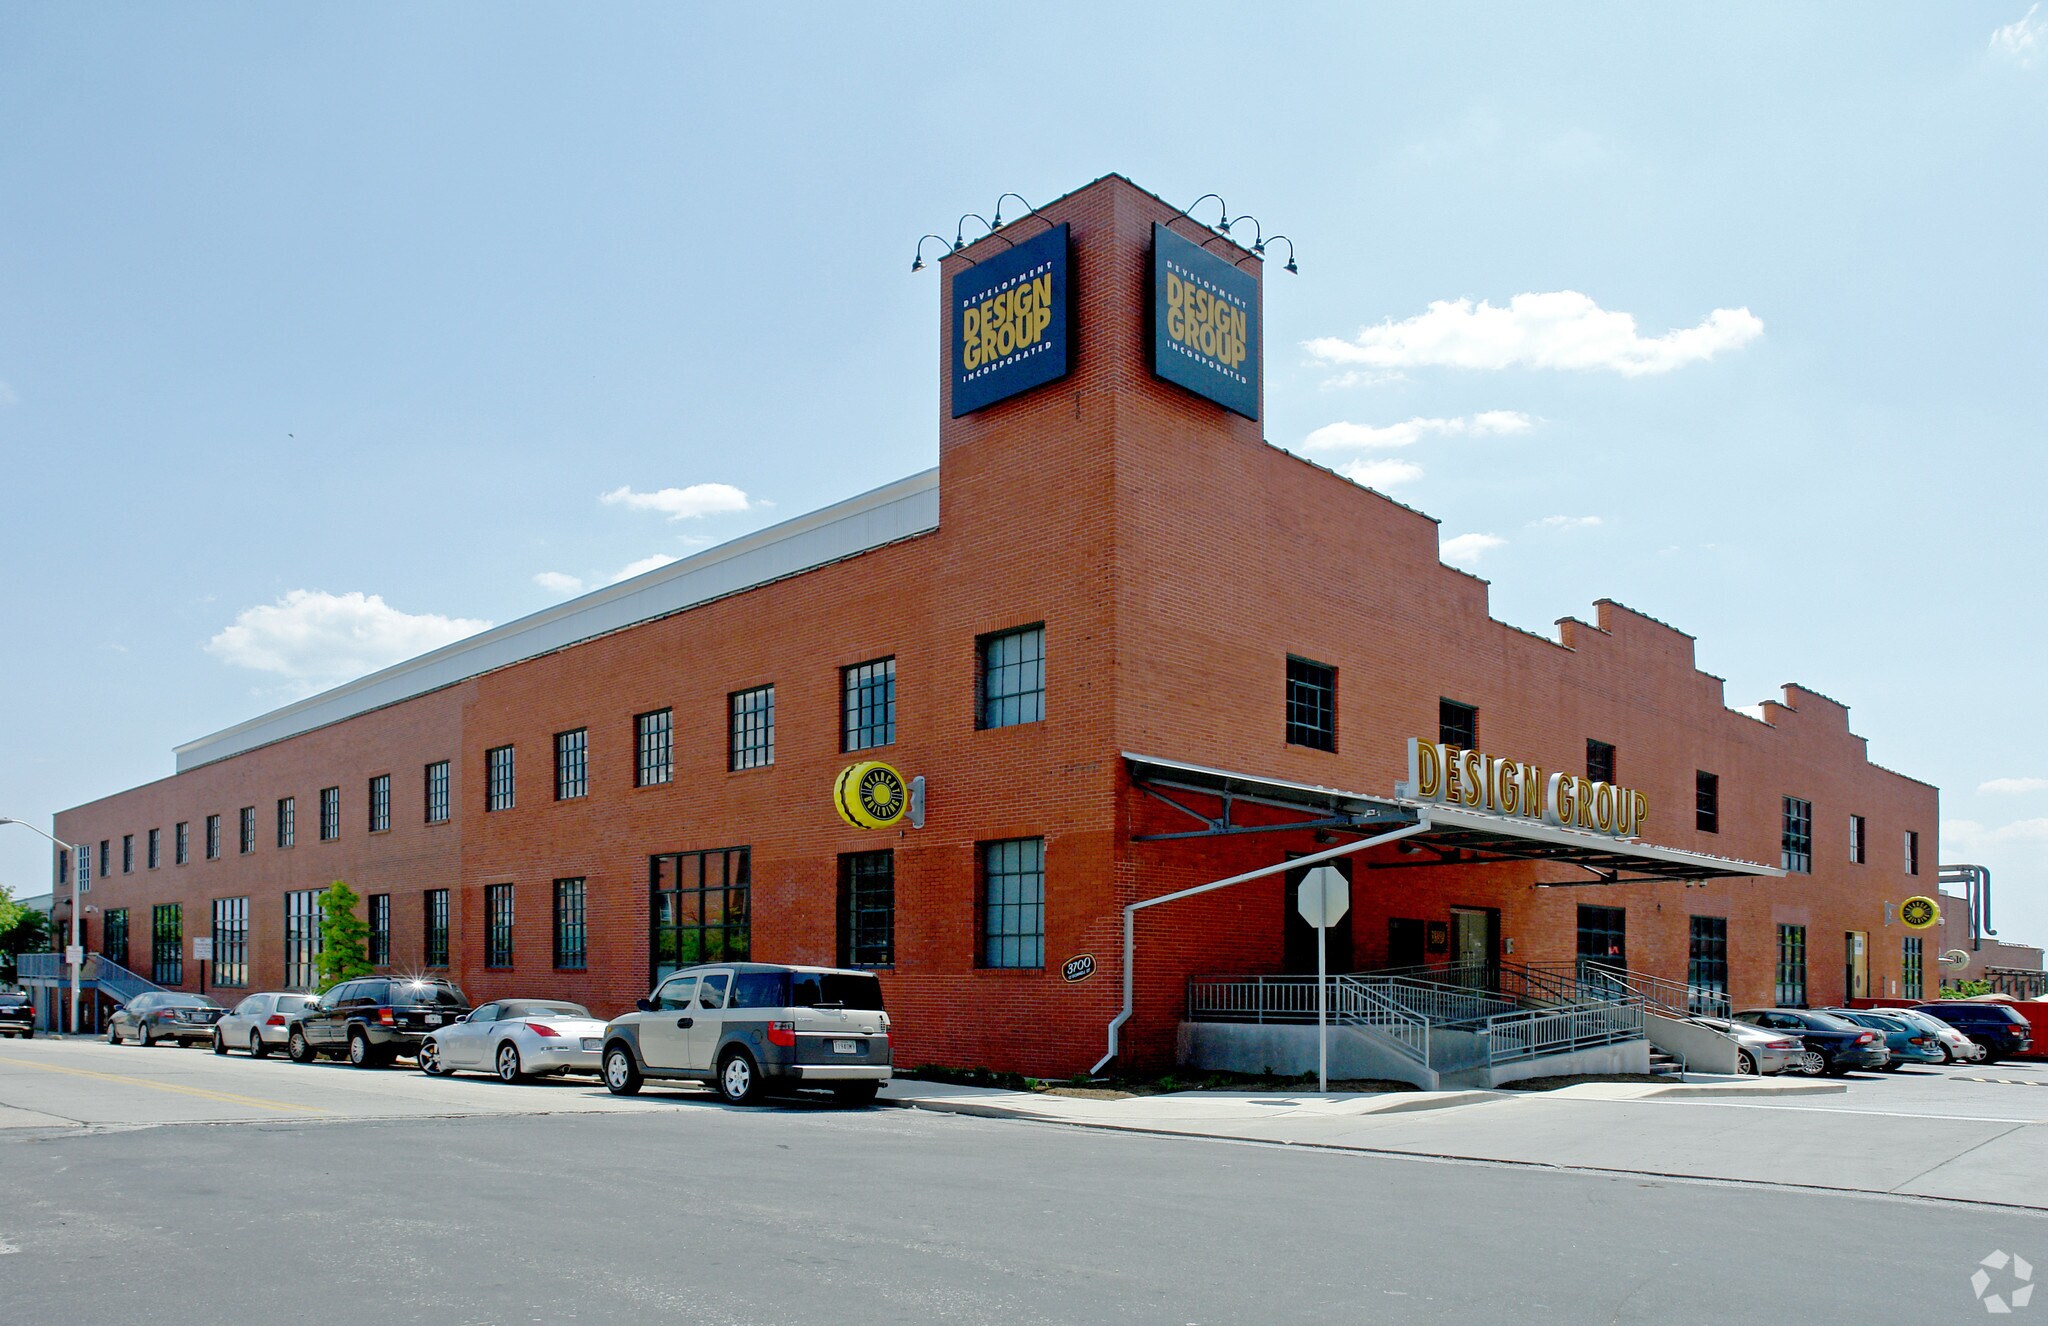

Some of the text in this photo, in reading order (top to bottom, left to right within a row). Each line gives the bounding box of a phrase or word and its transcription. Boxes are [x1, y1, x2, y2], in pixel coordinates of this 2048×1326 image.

[963, 261, 1052, 308] DEVELOPMENT
[963, 272, 1052, 342] DESIGN
[1167, 260, 1247, 309] DEVELOPMENT
[1167, 272, 1246, 344] DESIGN
[963, 307, 1051, 371] GROUP
[963, 341, 1052, 383] INCORPORATED
[1167, 306, 1246, 370] GROUP
[1167, 340, 1247, 384] INCORPORATED
[863, 771, 900, 793] BEARCAT
[1408, 737, 1649, 837] DESIGN GROUP
[863, 796, 900, 817] BUILDING
[1067, 957, 1091, 974] 3700
